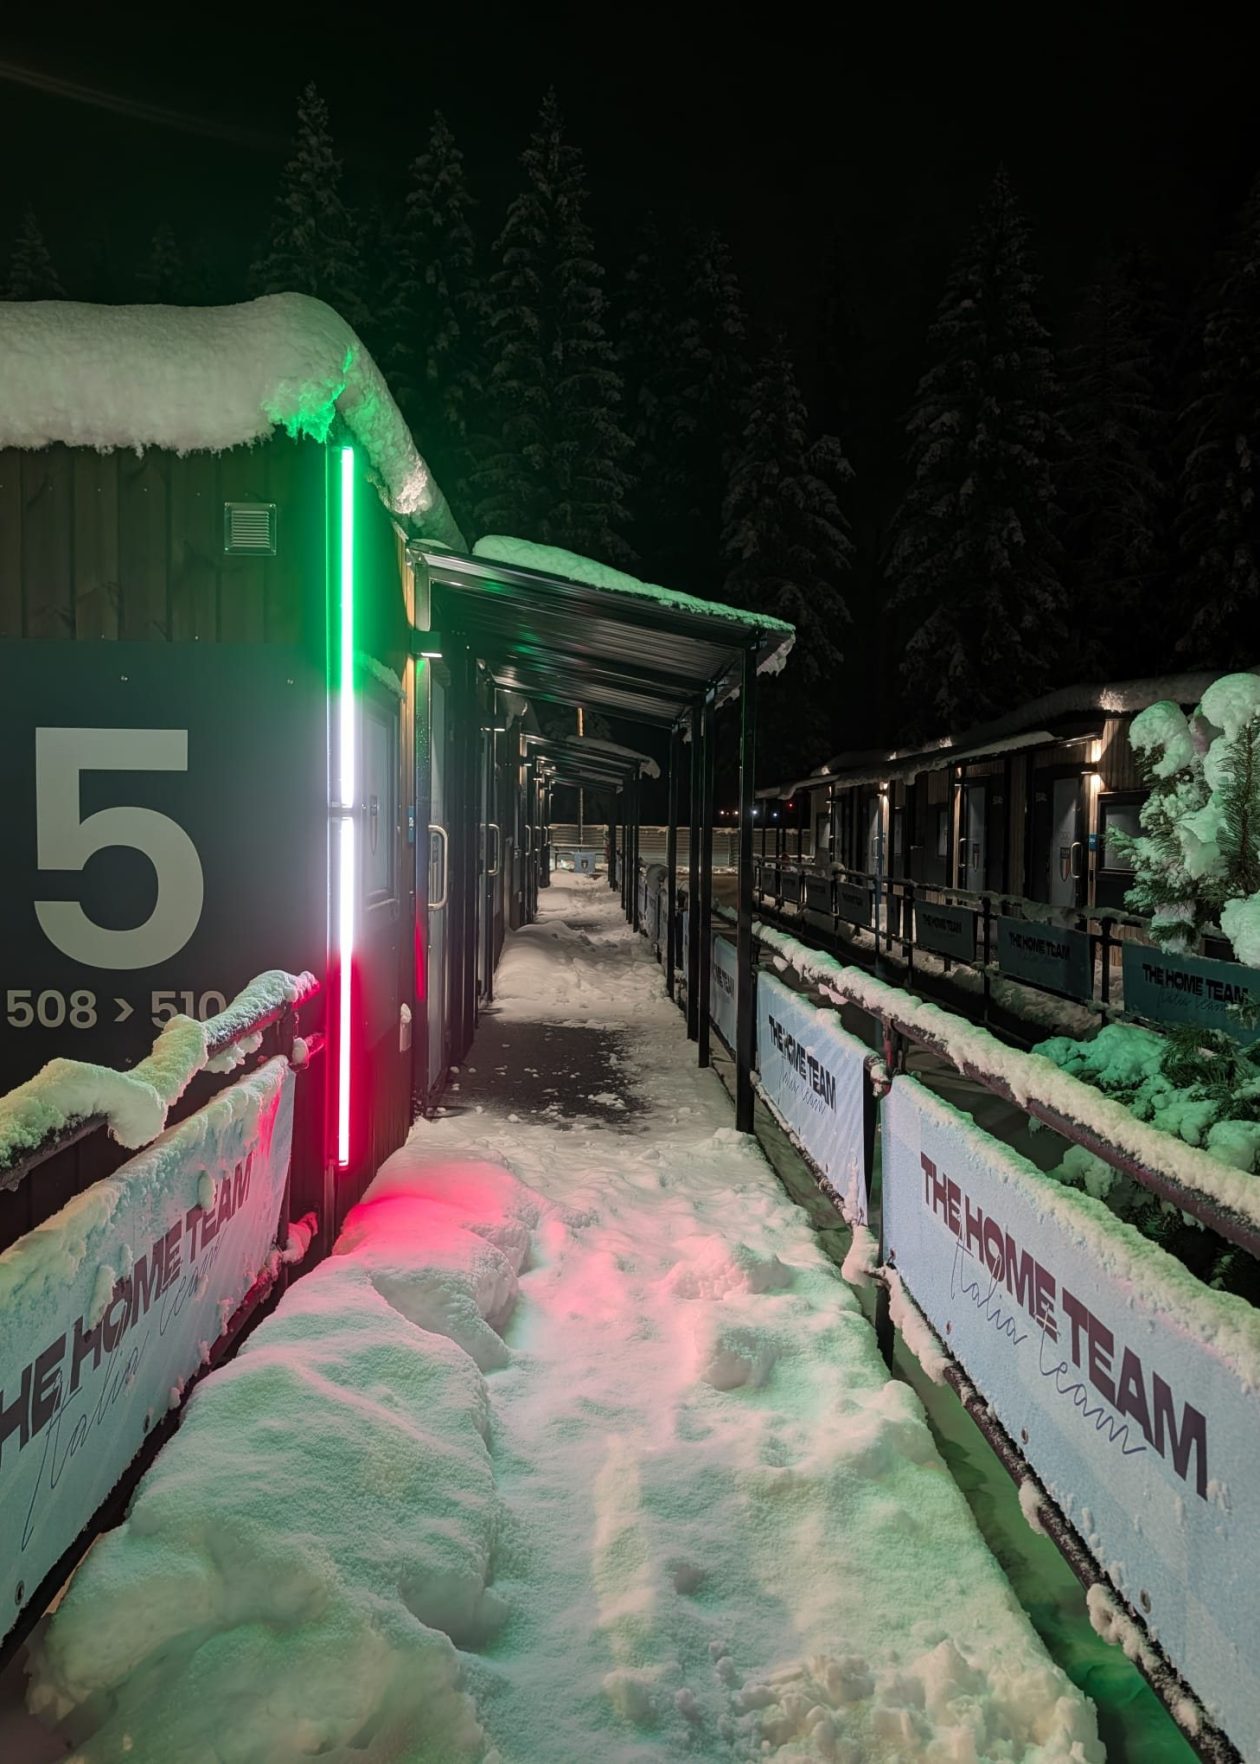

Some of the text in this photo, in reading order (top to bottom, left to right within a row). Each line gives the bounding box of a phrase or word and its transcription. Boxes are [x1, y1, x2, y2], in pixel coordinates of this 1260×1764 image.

[33, 726, 205, 970] 5
[6, 988, 98, 1029] 508
[150, 989, 228, 1030] 510
[768, 1014, 784, 1055] THE
[806, 1053, 837, 1113] TEAM
[1142, 963, 1164, 986] THE
[1165, 969, 1204, 997] HOME
[1205, 978, 1250, 1005] TEAM
[0, 1332, 66, 1470] HE
[185, 1150, 253, 1264] TEAM
[920, 1151, 1208, 1502] THE HOME TEAM
